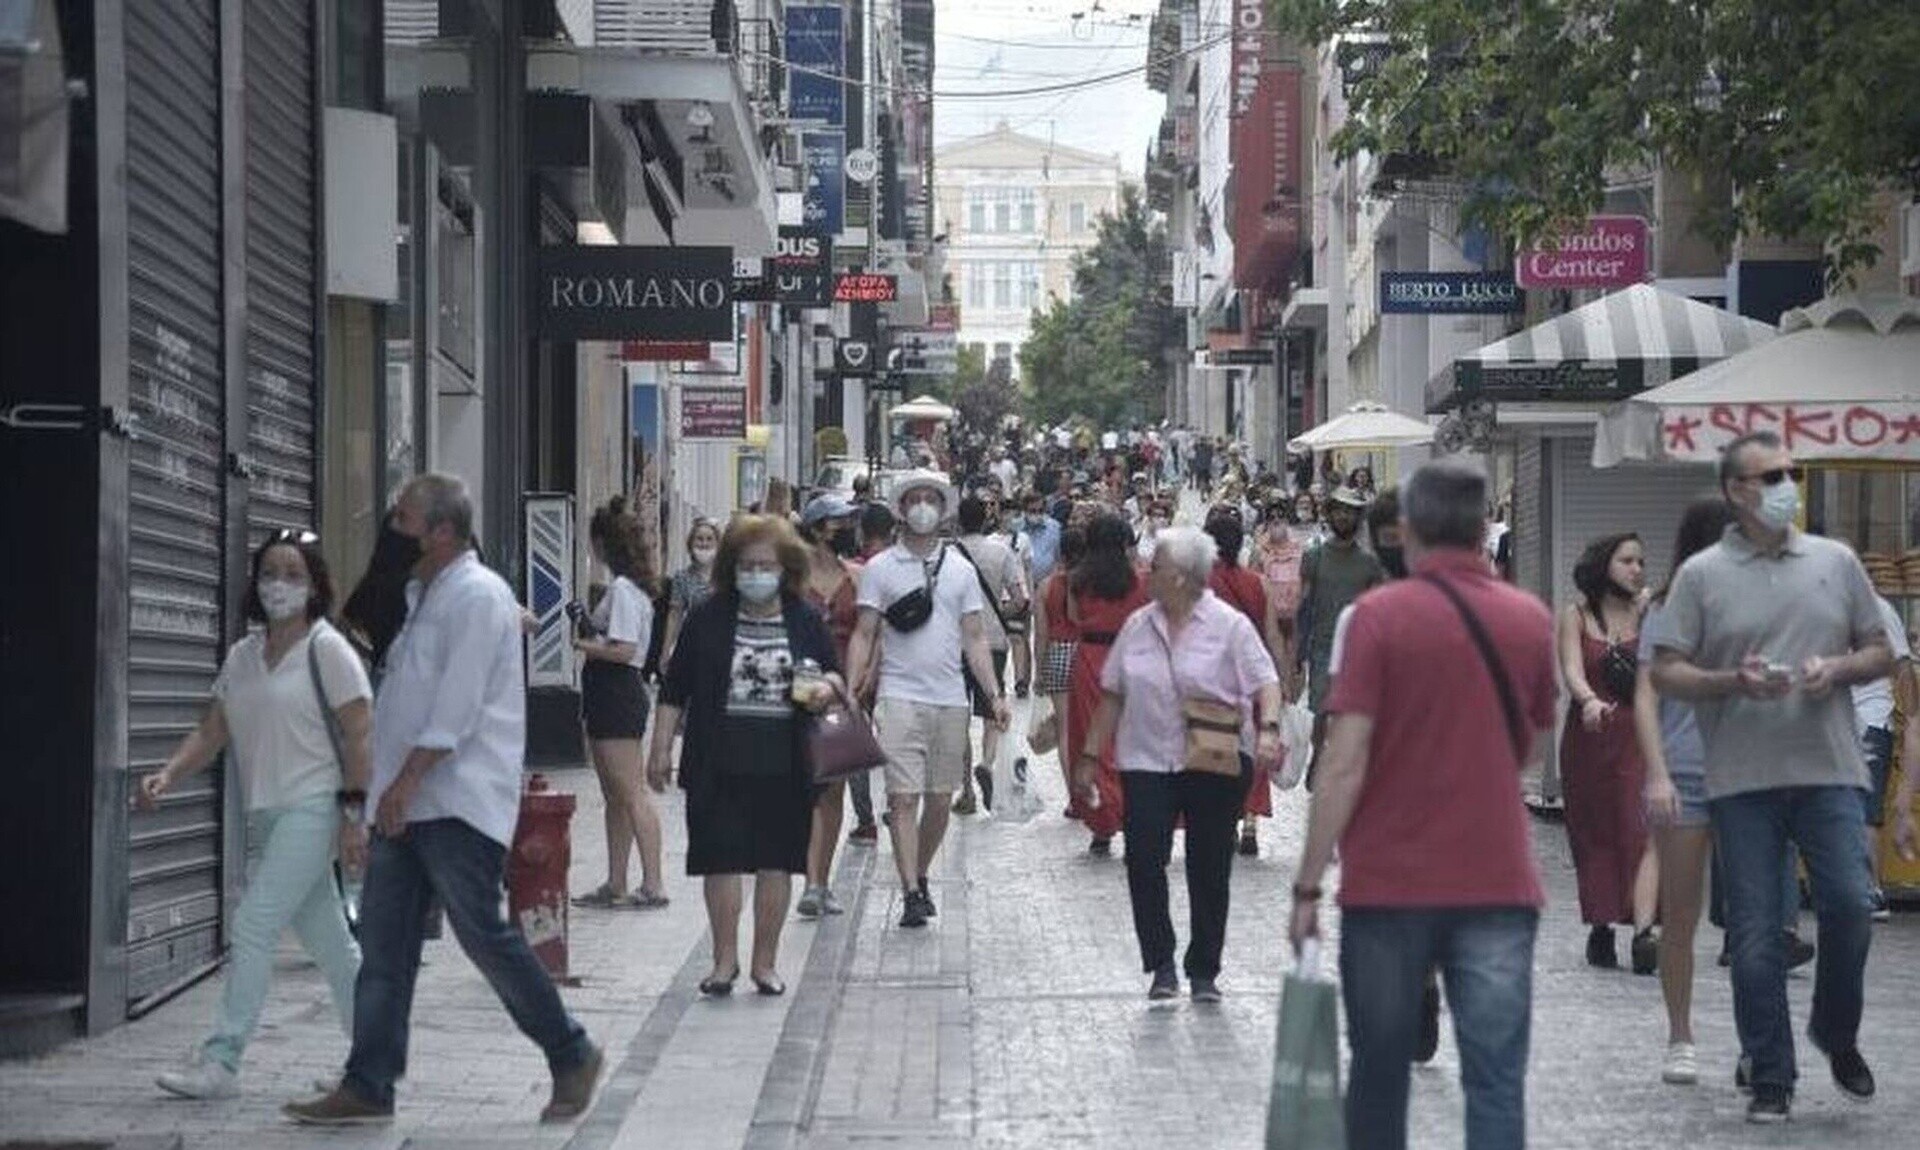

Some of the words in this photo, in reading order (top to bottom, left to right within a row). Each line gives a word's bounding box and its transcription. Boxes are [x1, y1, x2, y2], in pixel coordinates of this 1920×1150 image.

[1530, 252, 1624, 277] Center
[551, 277, 725, 308] ROMANO
[1389, 282, 1450, 298] BERTO
[1461, 282, 1516, 298] LUCCI
